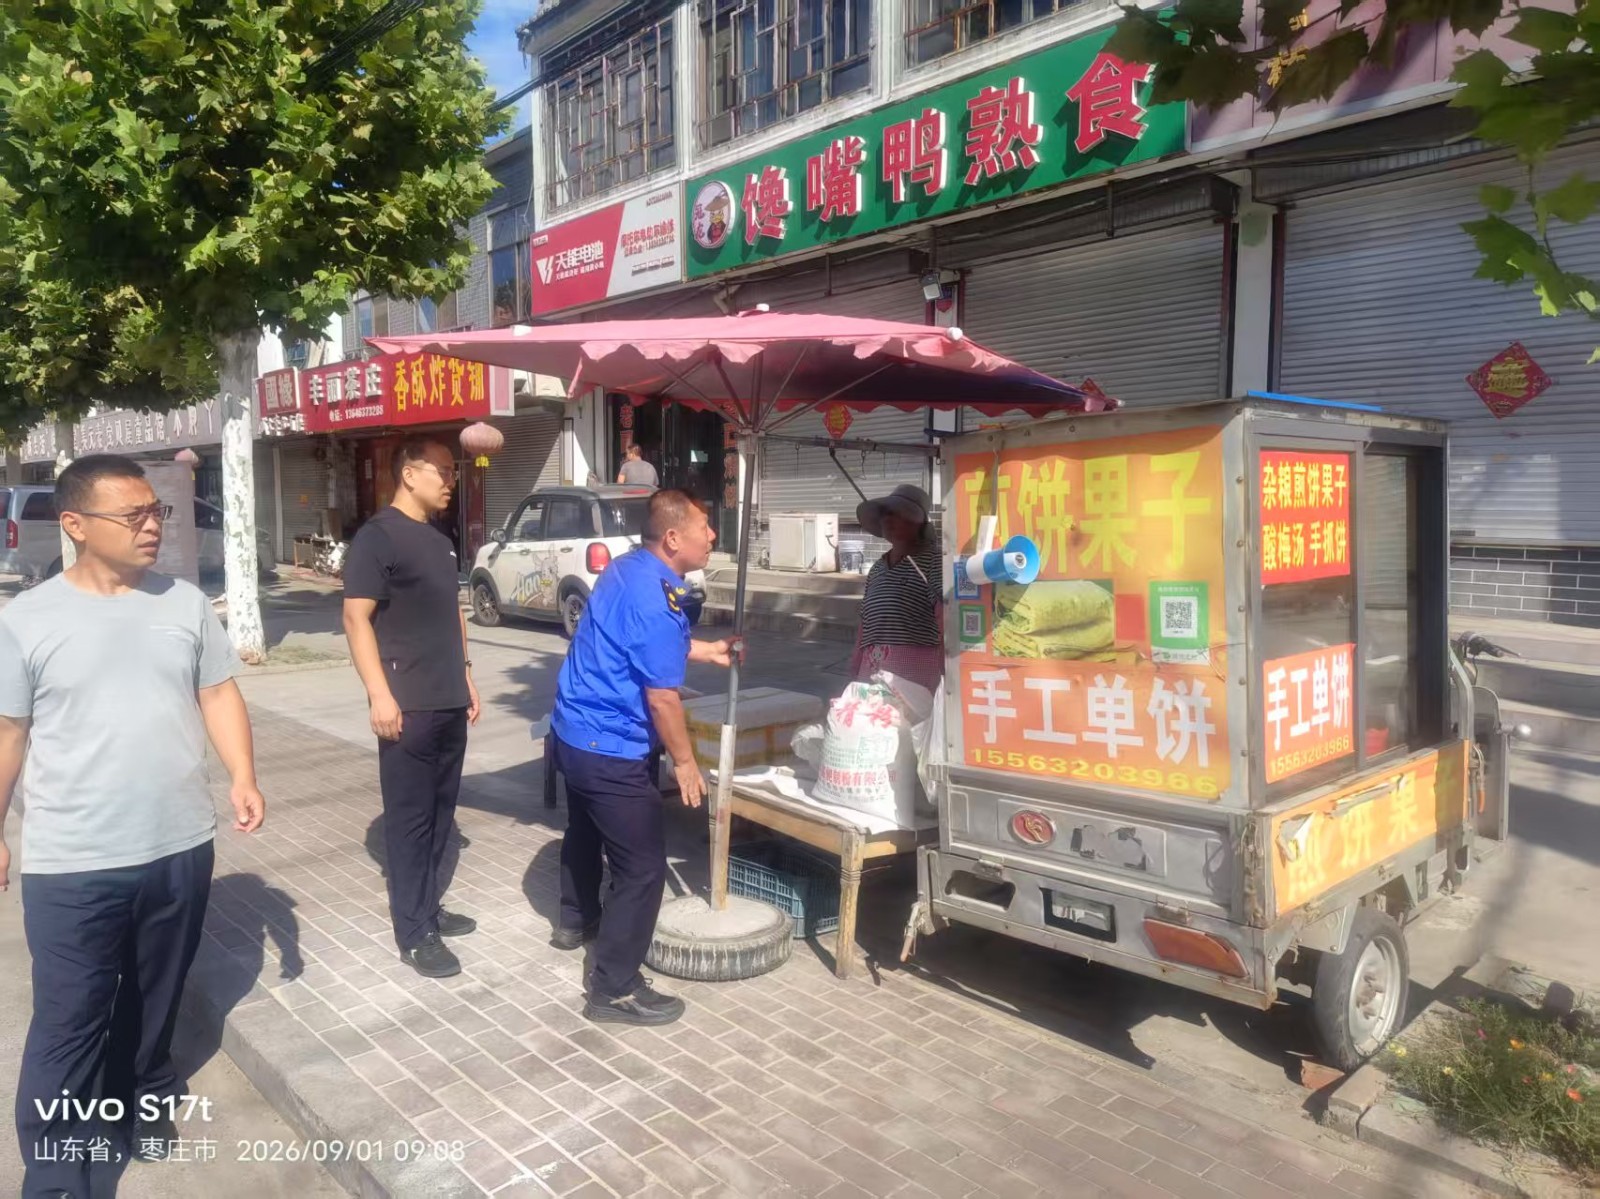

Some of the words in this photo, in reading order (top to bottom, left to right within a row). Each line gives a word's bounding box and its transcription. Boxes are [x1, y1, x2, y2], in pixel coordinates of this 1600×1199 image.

[741, 53, 1157, 246] 馋嘴鸭熟食
[555, 240, 604, 271] 天能电池
[1262, 461, 1347, 510] 杂粮煎饼果子
[1262, 522, 1305, 571] 酸梅汤
[1309, 520, 1347, 567] 手抓饼
[967, 669, 1216, 769] 手工单饼
[1267, 651, 1350, 751] 手工单饼
